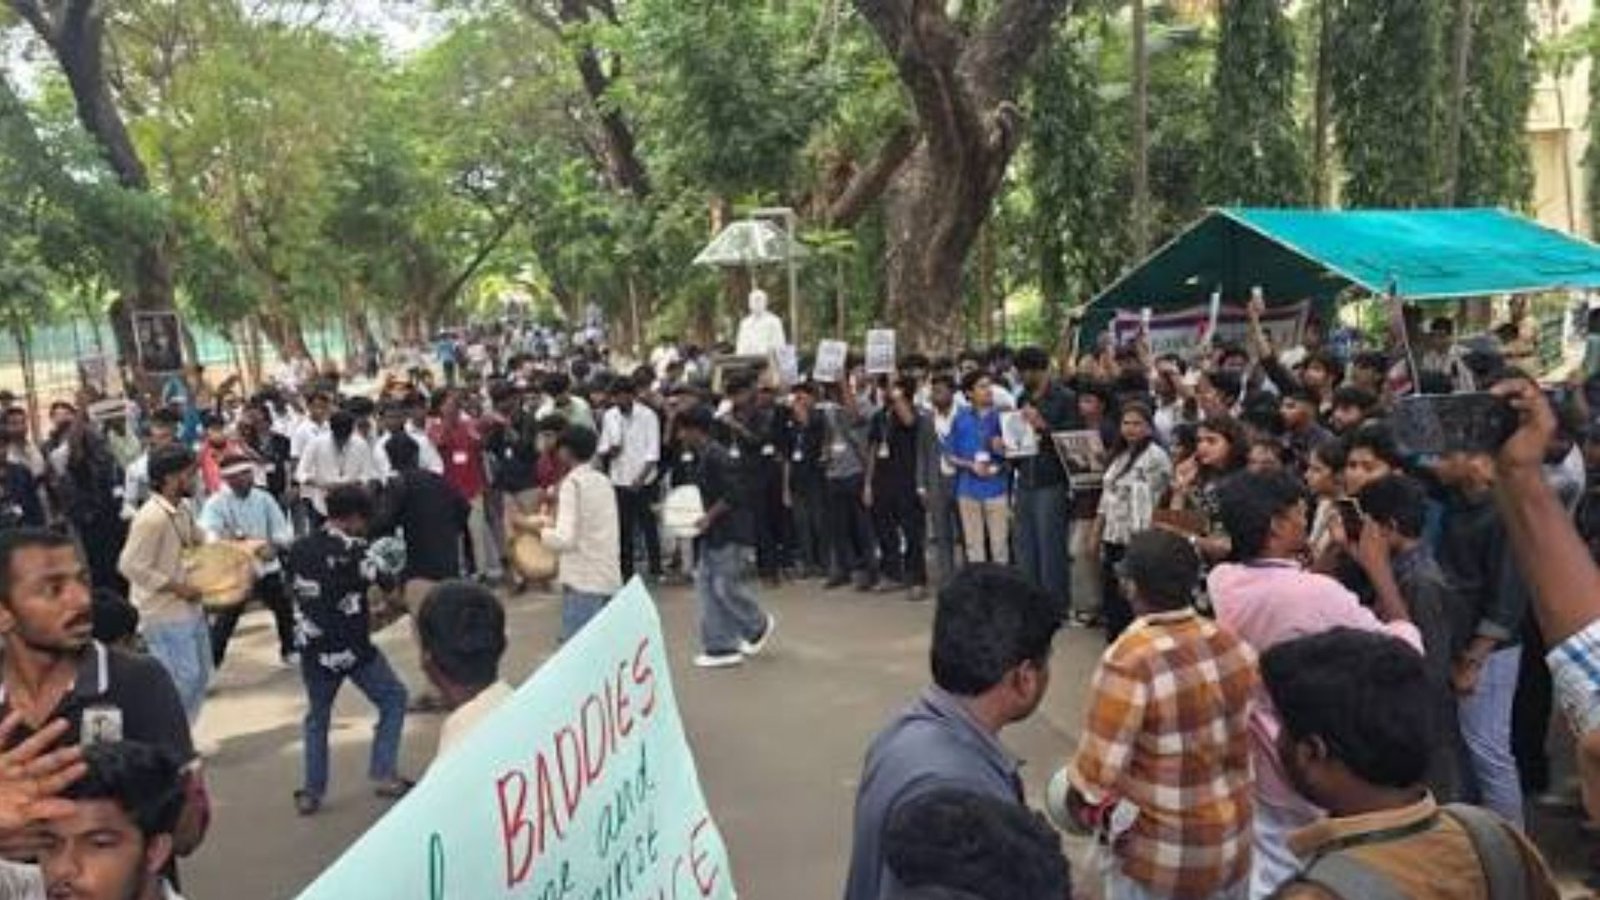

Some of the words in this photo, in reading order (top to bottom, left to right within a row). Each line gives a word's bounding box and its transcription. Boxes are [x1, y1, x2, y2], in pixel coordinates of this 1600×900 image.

[496, 637, 655, 888] BADDIES
[598, 740, 655, 858] and
[659, 817, 719, 900] CE
